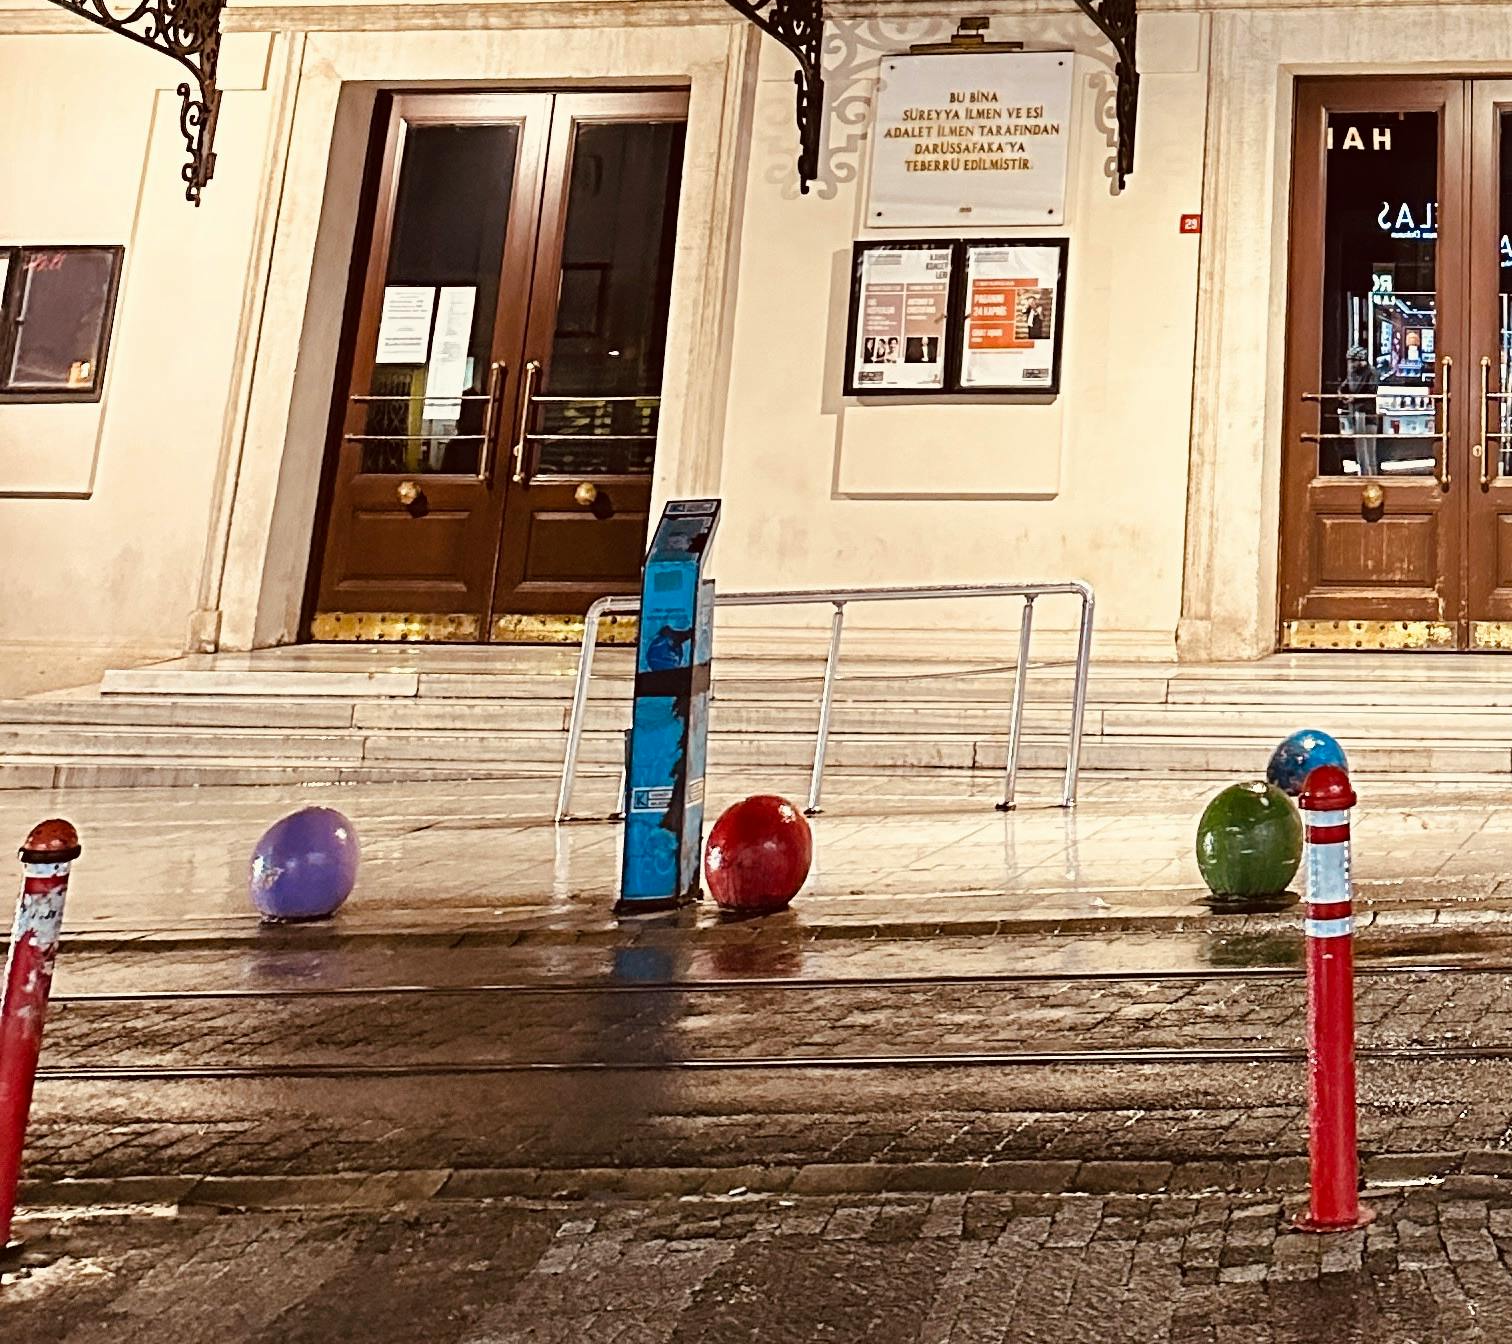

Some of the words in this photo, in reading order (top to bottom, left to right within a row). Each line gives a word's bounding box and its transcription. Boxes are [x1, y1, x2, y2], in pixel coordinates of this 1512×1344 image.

[949, 92, 966, 104] BU
[969, 90, 998, 103] BİNA
[902, 108, 960, 121] SÜREYYA
[965, 107, 1002, 120] İLMEN
[1007, 107, 1022, 119] VE
[884, 127, 932, 139] ADALET
[937, 125, 974, 138] İLMEN
[979, 123, 1060, 137] TARAFINDAN
[905, 158, 960, 173] TEBERRÜ
